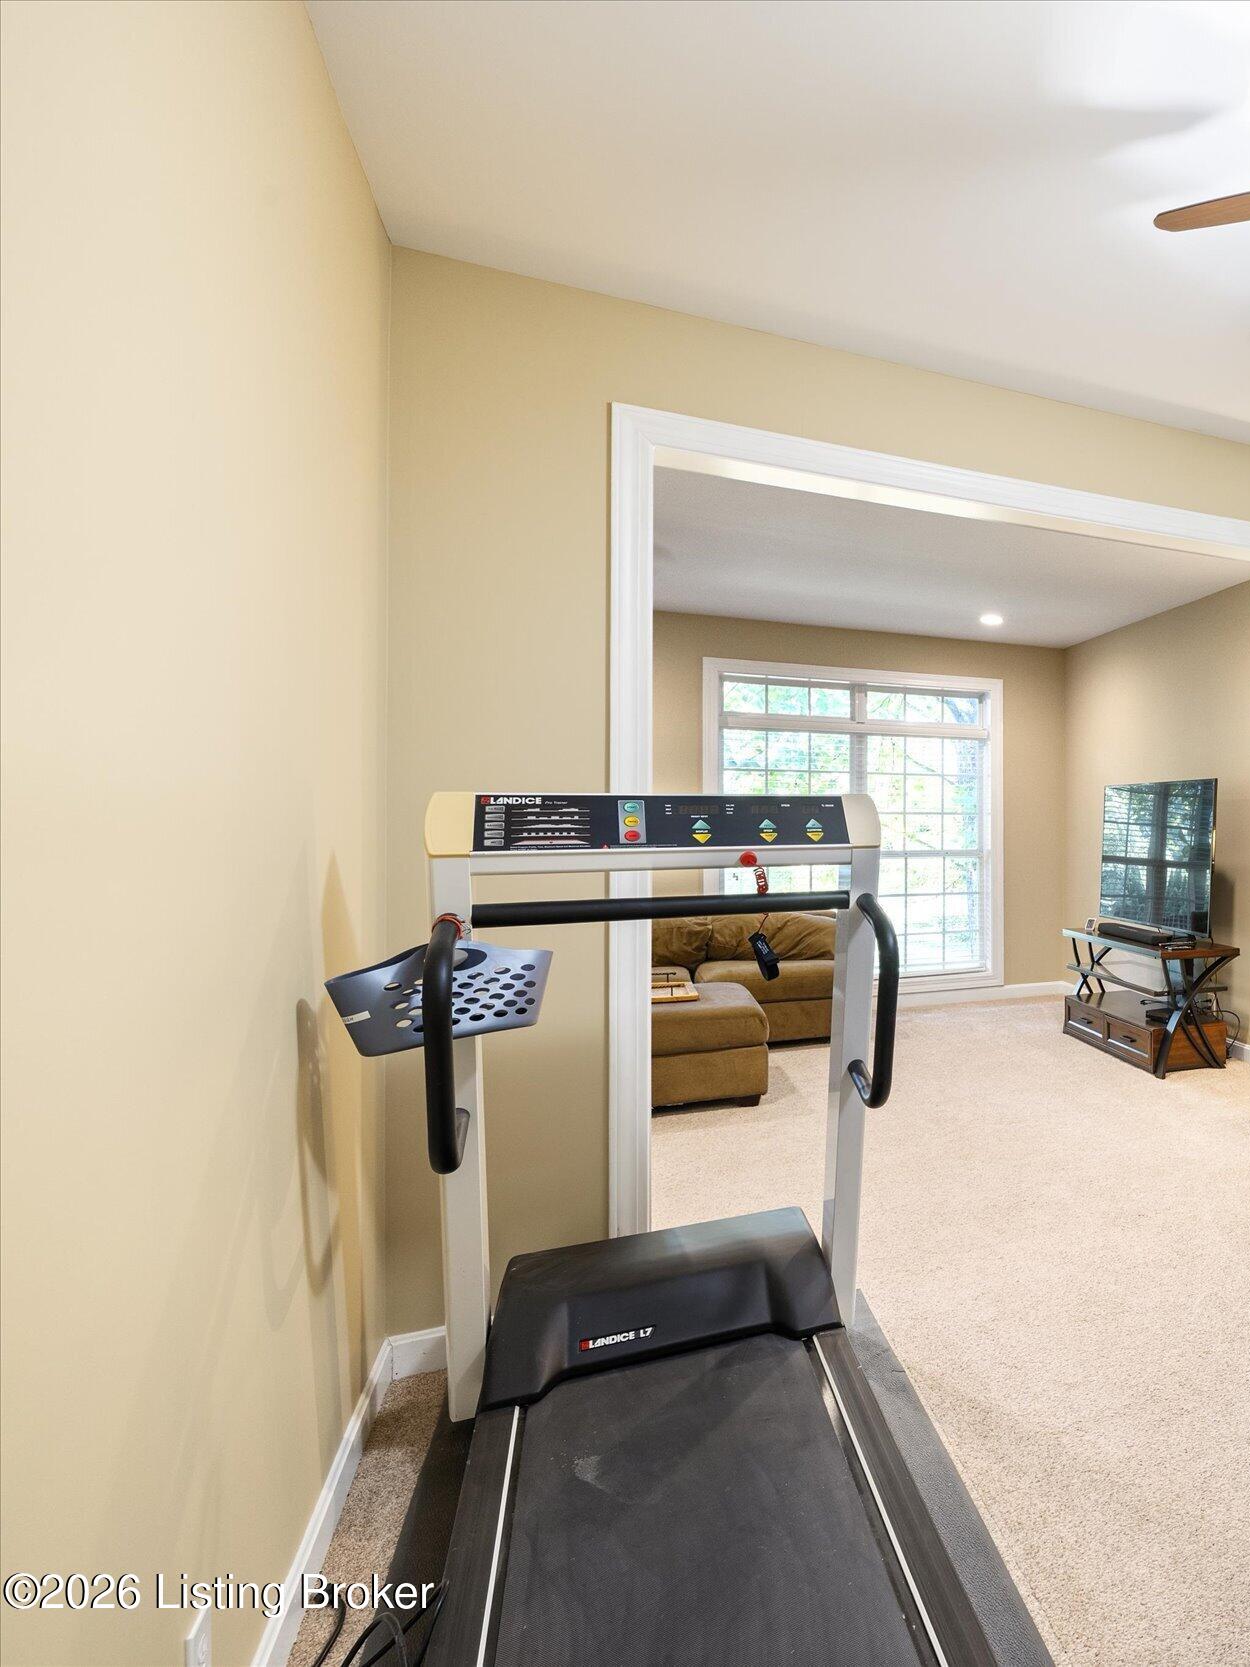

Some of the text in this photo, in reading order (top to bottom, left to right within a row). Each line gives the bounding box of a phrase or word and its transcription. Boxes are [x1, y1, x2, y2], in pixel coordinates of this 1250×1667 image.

[490, 797, 542, 805] LANDICE
[588, 1327, 653, 1349] LANDICE L7
